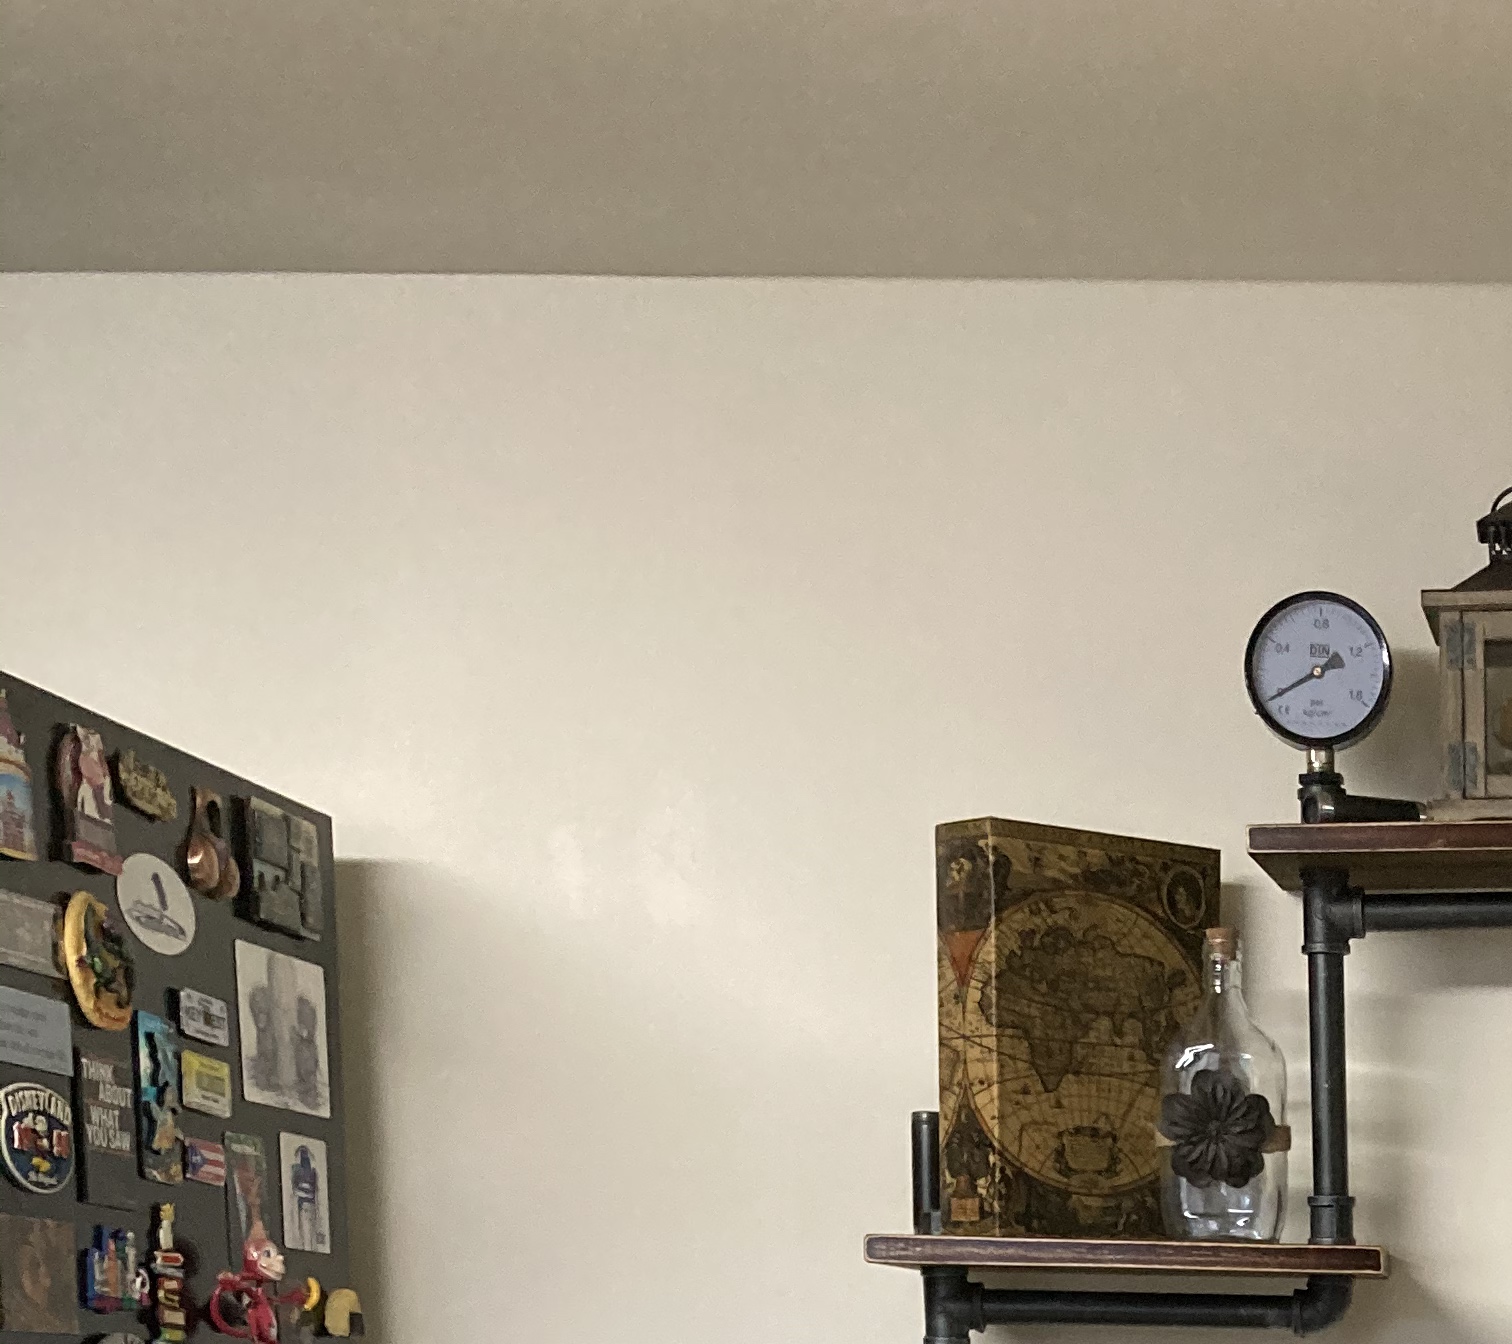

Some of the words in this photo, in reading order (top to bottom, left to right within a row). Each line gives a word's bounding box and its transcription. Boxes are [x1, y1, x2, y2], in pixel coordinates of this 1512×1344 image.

[1310, 644, 1330, 658] DIN
[81, 1057, 115, 1085] THINK
[98, 1080, 132, 1109] ABOUT
[90, 1105, 119, 1131] WHAT
